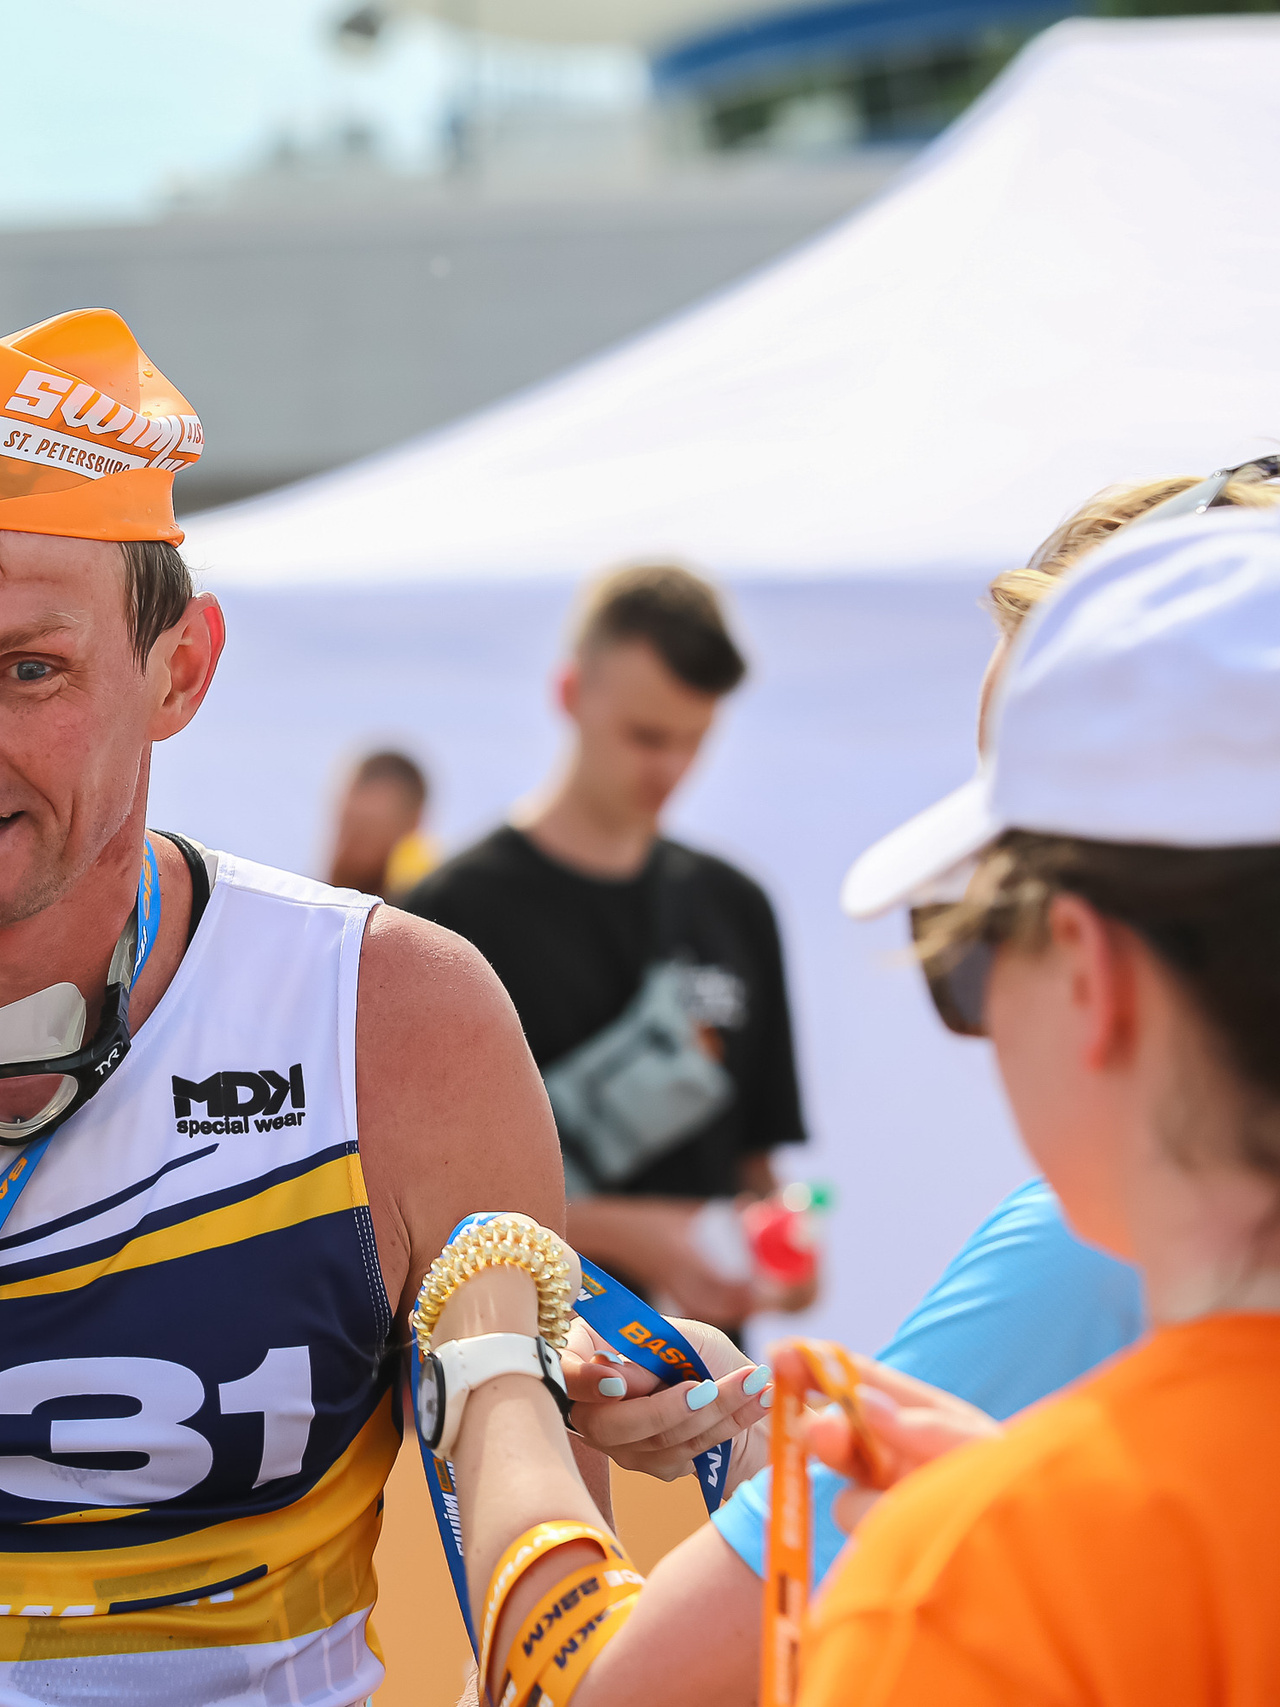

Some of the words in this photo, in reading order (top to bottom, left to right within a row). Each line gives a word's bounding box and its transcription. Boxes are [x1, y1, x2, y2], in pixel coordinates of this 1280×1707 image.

[4, 430, 33, 453] ST.
[94, 1047, 120, 1076] TYR
[176, 1115, 251, 1139] special
[253, 1111, 306, 1134] wear
